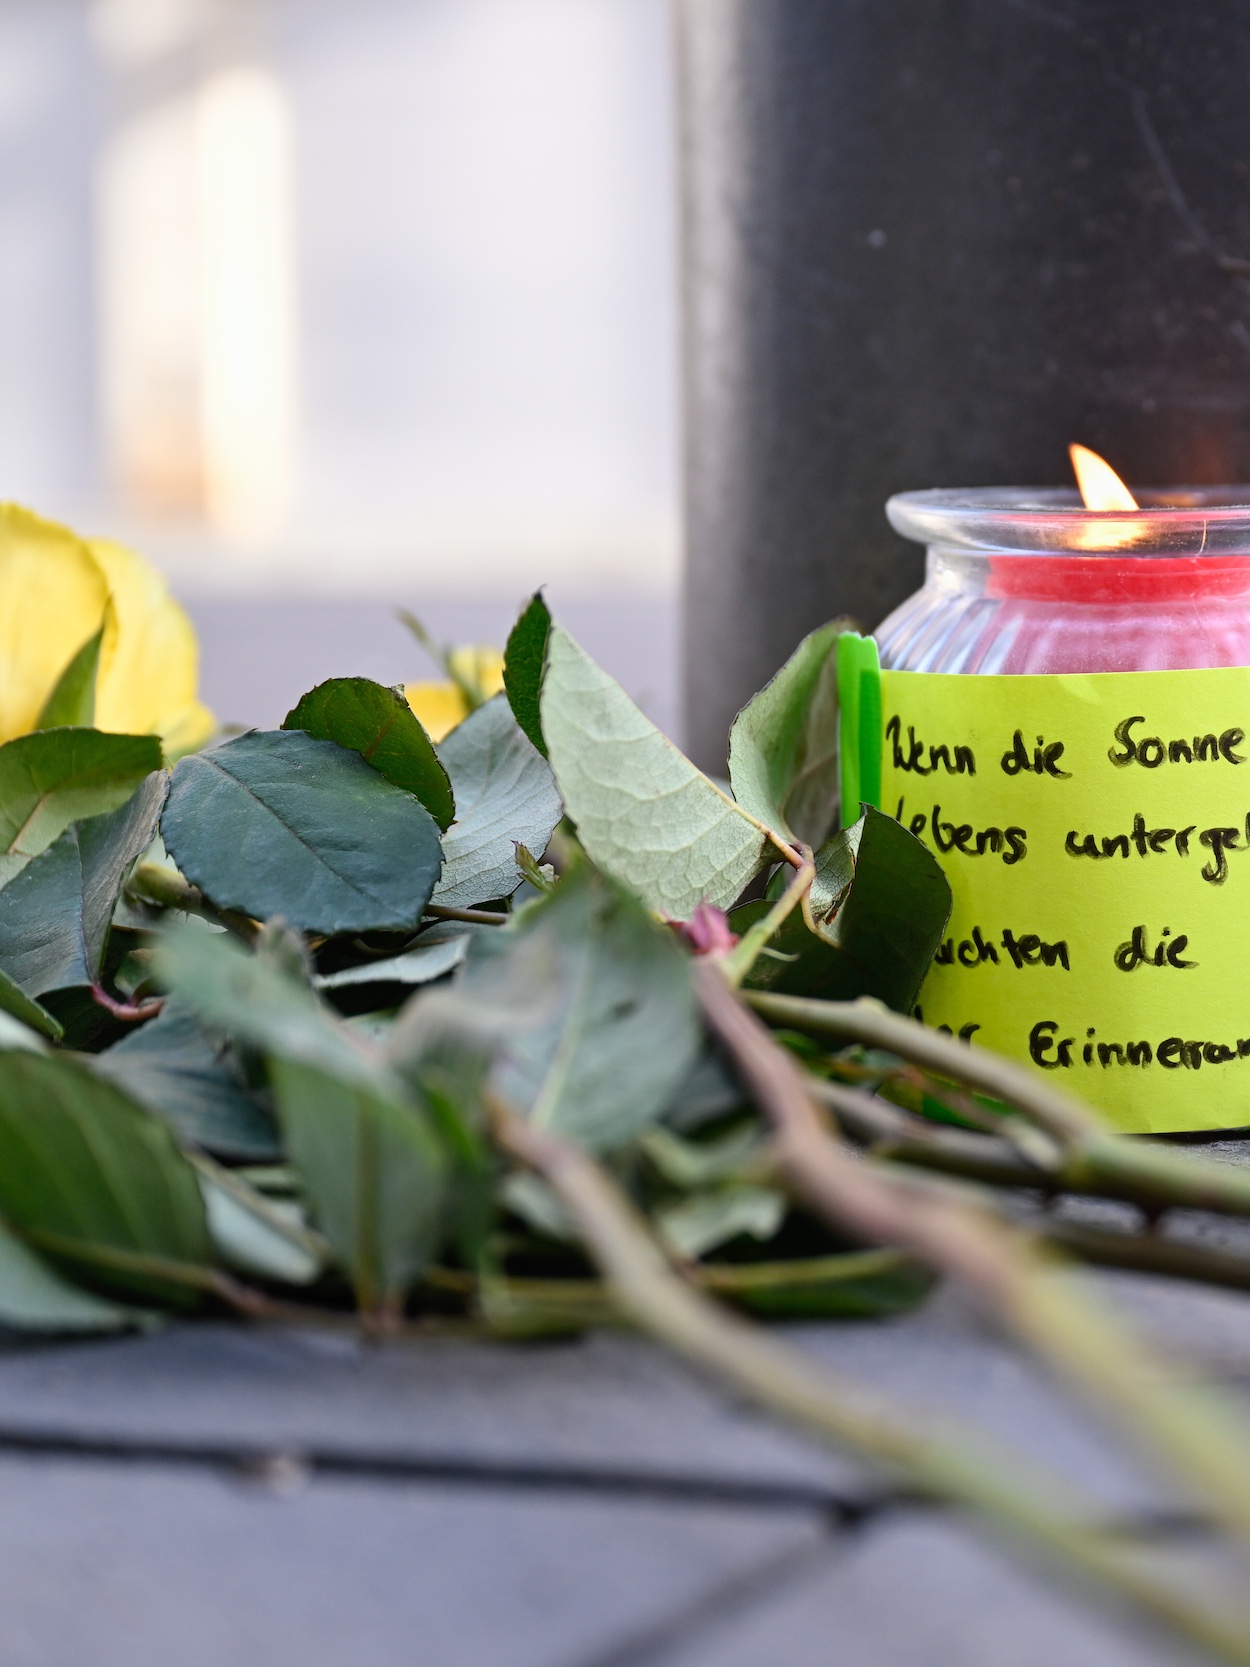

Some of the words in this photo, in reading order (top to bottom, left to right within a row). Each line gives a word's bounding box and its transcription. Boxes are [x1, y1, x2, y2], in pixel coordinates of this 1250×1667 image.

[886, 714, 976, 777] Wenn
[1000, 728, 1073, 780] die
[1107, 715, 1248, 769] Sonne
[1114, 926, 1199, 973] die
